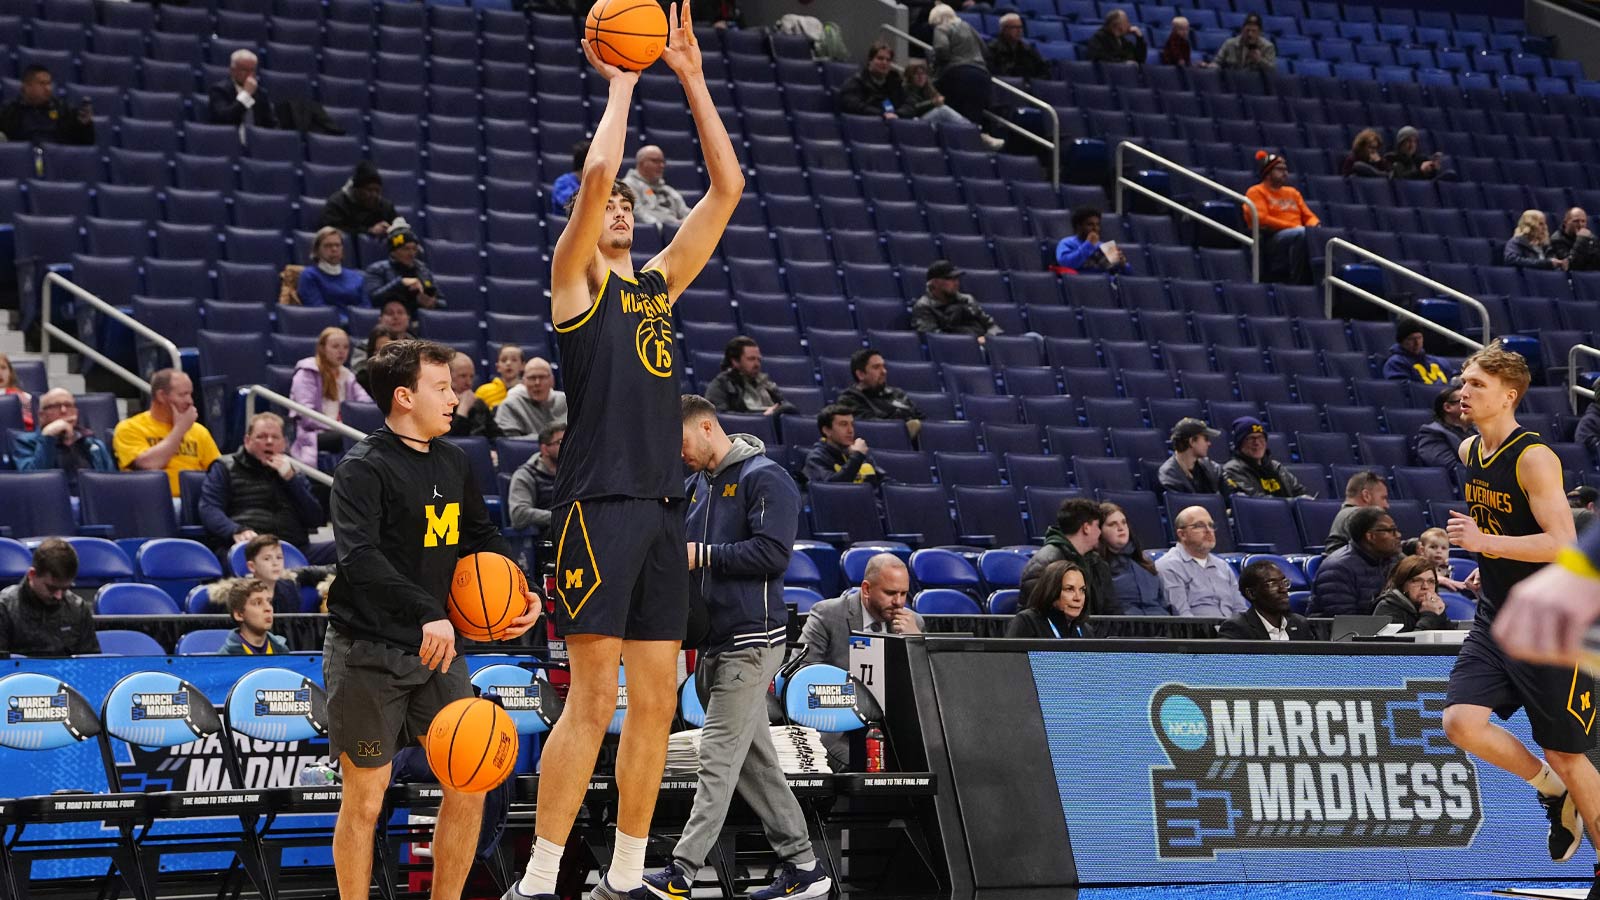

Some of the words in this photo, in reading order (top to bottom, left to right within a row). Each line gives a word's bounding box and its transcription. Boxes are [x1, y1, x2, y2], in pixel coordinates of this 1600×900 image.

[655, 339, 672, 368] 15
[1413, 363, 1448, 385] M
[722, 483, 738, 497] M
[424, 502, 460, 547] M
[565, 568, 584, 589] M
[496, 687, 525, 697] MARCH
[815, 685, 842, 695] MARCH
[18, 697, 51, 708] MARCH
[141, 694, 173, 706] MARCH
[264, 691, 295, 702] MARCH
[501, 697, 540, 707] MADNESS
[820, 695, 856, 705] MADNESS
[146, 704, 189, 716] MADNESS
[269, 701, 311, 712] MADNESS
[23, 707, 68, 719] MADNESS
[1210, 699, 1377, 756] MARCH
[357, 740, 382, 756] M
[303, 792, 313, 800] THE
[314, 792, 329, 800] ROAD
[329, 792, 336, 800] TO
[1247, 762, 1474, 821] MADNESS
[55, 802, 66, 810] THE
[83, 801, 91, 809] TO
[91, 801, 102, 809] THE
[103, 800, 119, 808] FINAL
[119, 800, 136, 808] FOUR
[183, 797, 194, 805] THE
[209, 796, 217, 804] TO
[228, 795, 244, 803] FINAL
